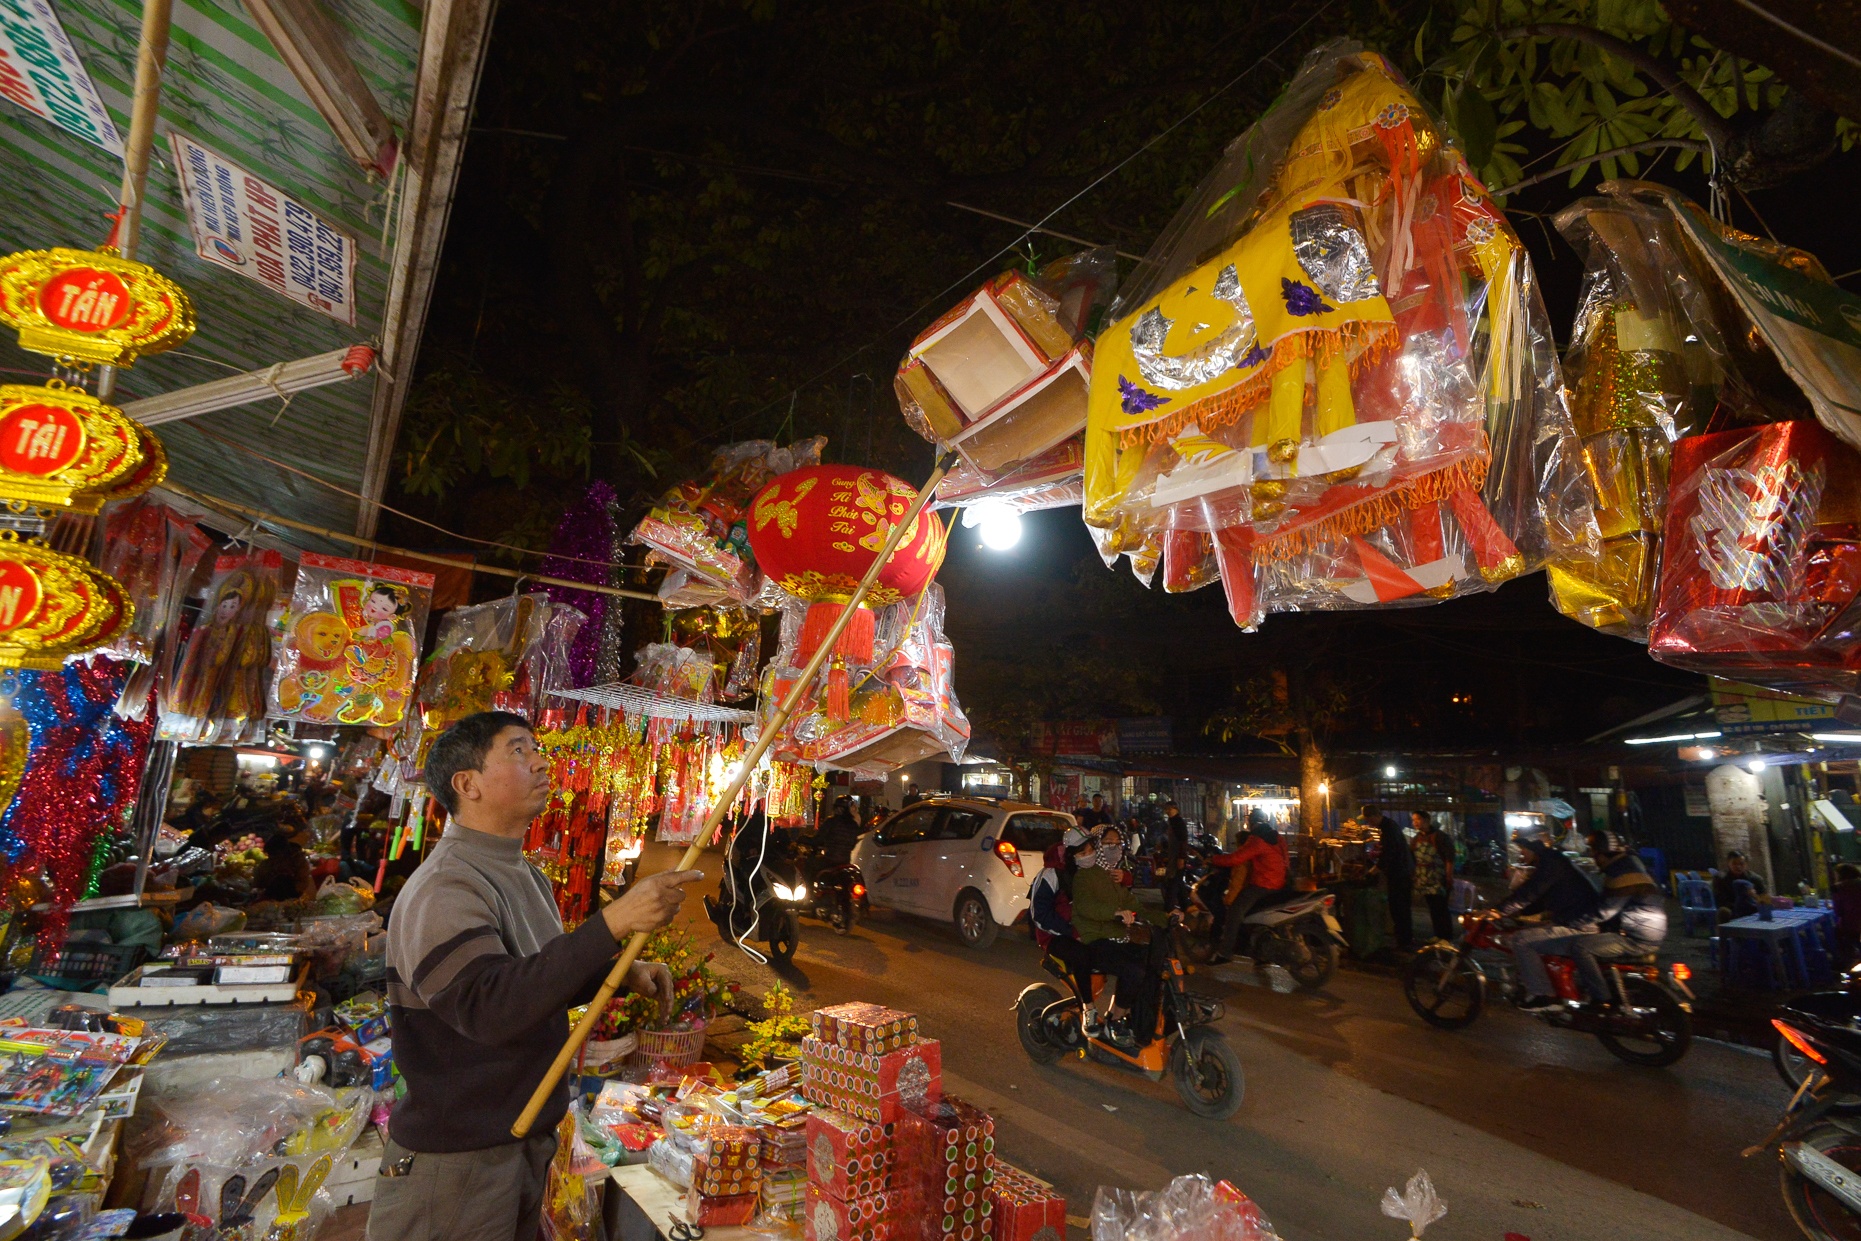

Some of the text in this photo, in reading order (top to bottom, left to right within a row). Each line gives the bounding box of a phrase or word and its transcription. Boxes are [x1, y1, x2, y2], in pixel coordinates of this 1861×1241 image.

[187, 145, 221, 235] MÁI HIÊN DI ĐỘNG
[215, 164, 235, 196] ĐỘNG
[220, 193, 235, 208] DI
[224, 222, 242, 243] MÁI
[243, 177, 287, 289] HÒA PHÁT HP
[284, 201, 317, 291] 0422.390.479
[58, 277, 119, 327] TẤN
[15, 413, 68, 460] TÀI
[831, 477, 856, 489] Cung
[828, 505, 859, 519] Phát
[830, 521, 856, 535] Tài
